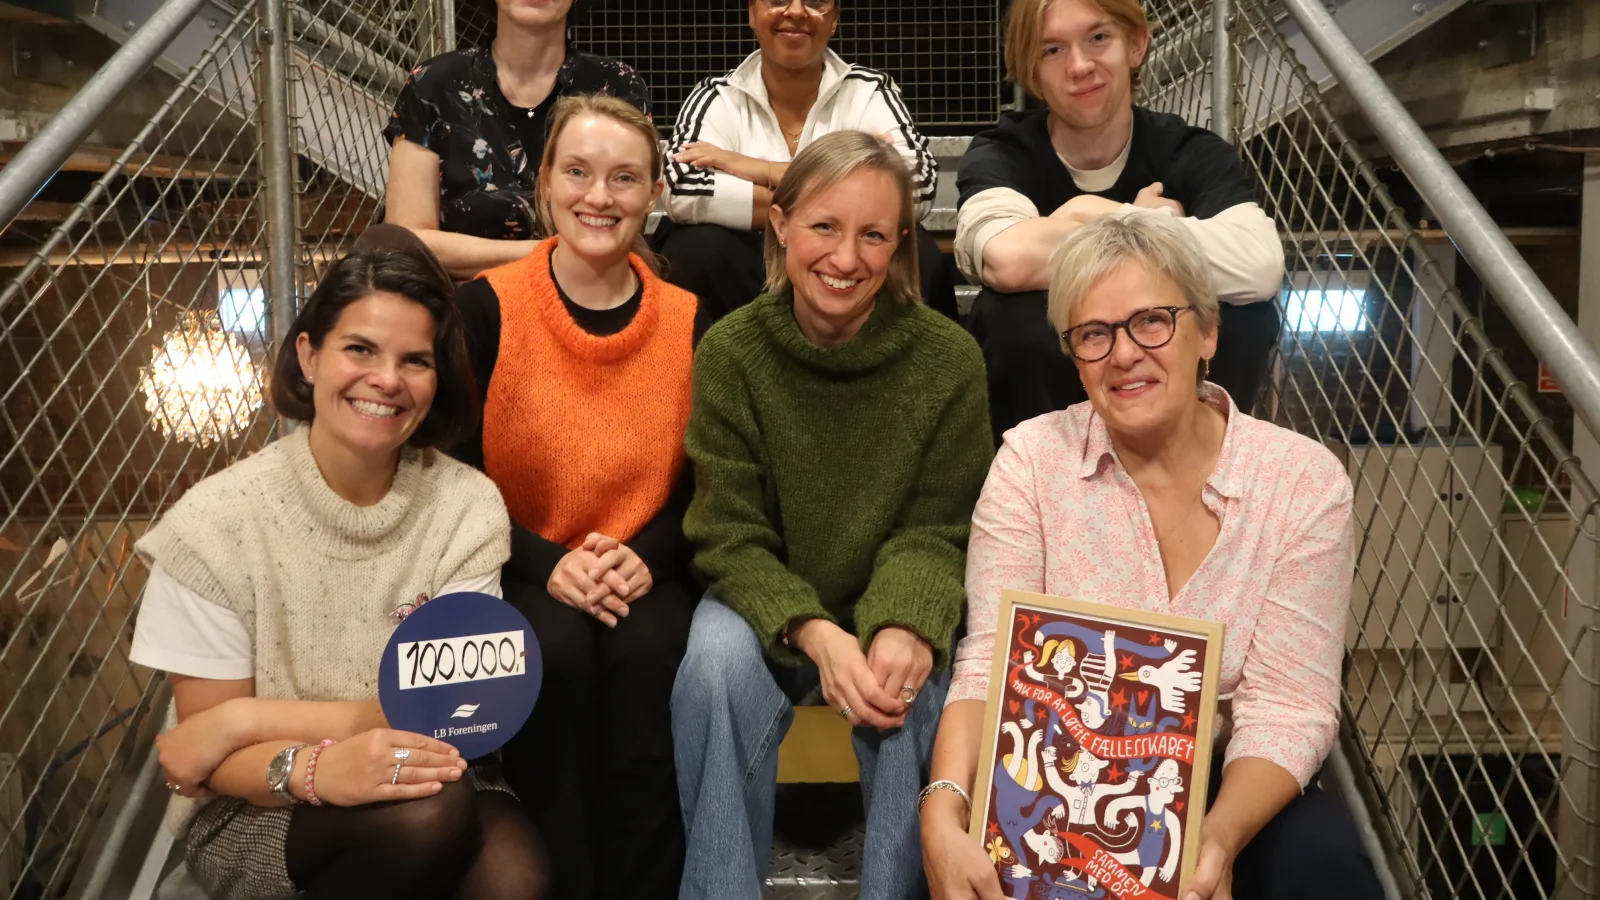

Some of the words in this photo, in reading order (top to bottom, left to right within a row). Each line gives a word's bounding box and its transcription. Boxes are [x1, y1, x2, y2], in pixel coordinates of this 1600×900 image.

[1032, 688, 1053, 703] FOR
[434, 728, 447, 739] LB
[448, 722, 498, 737] Foreningen
[1085, 860, 1112, 884] MED
[1092, 849, 1147, 896] SAMMEN
